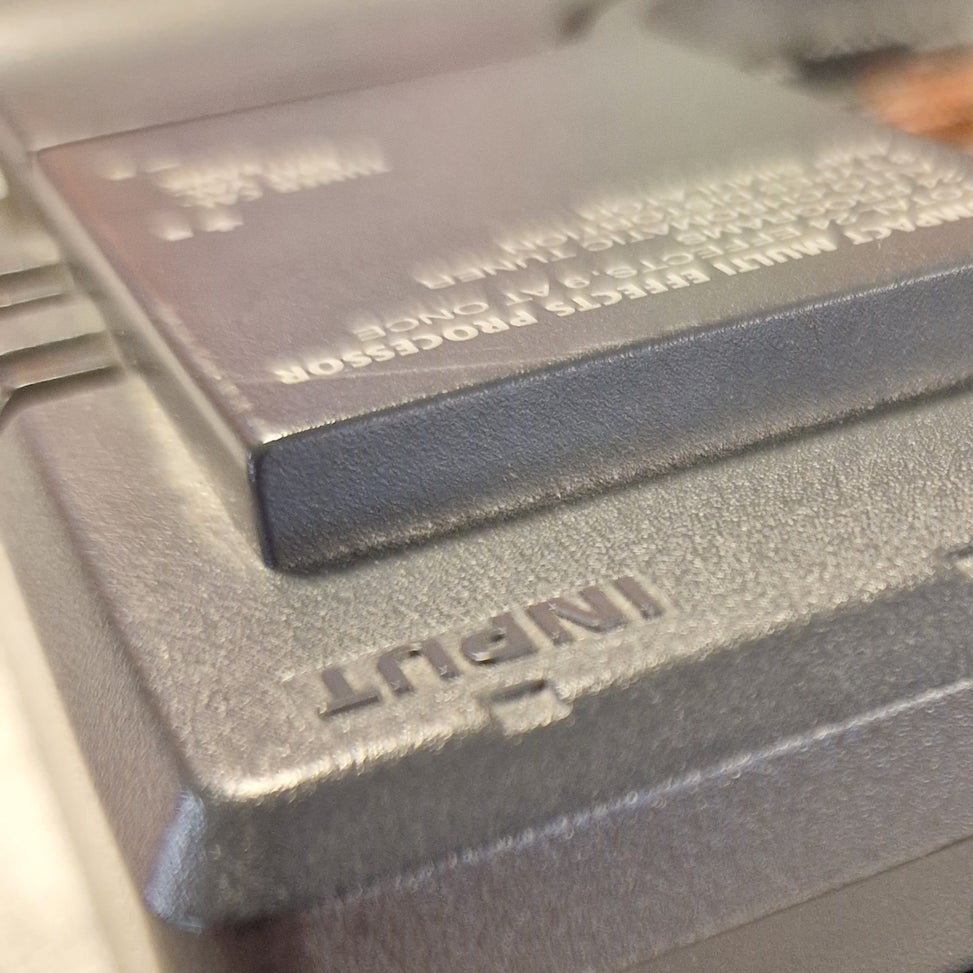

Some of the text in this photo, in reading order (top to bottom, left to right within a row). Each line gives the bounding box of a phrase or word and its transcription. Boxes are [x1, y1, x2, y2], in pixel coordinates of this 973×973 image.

[416, 248, 576, 291] TUNER
[713, 236, 838, 276] MULTI
[505, 283, 549, 306] AT
[545, 268, 711, 318] EFFECTS
[353, 300, 489, 342] ONCE
[273, 309, 538, 386] PROCESSOR
[317, 575, 664, 718] INPUT
